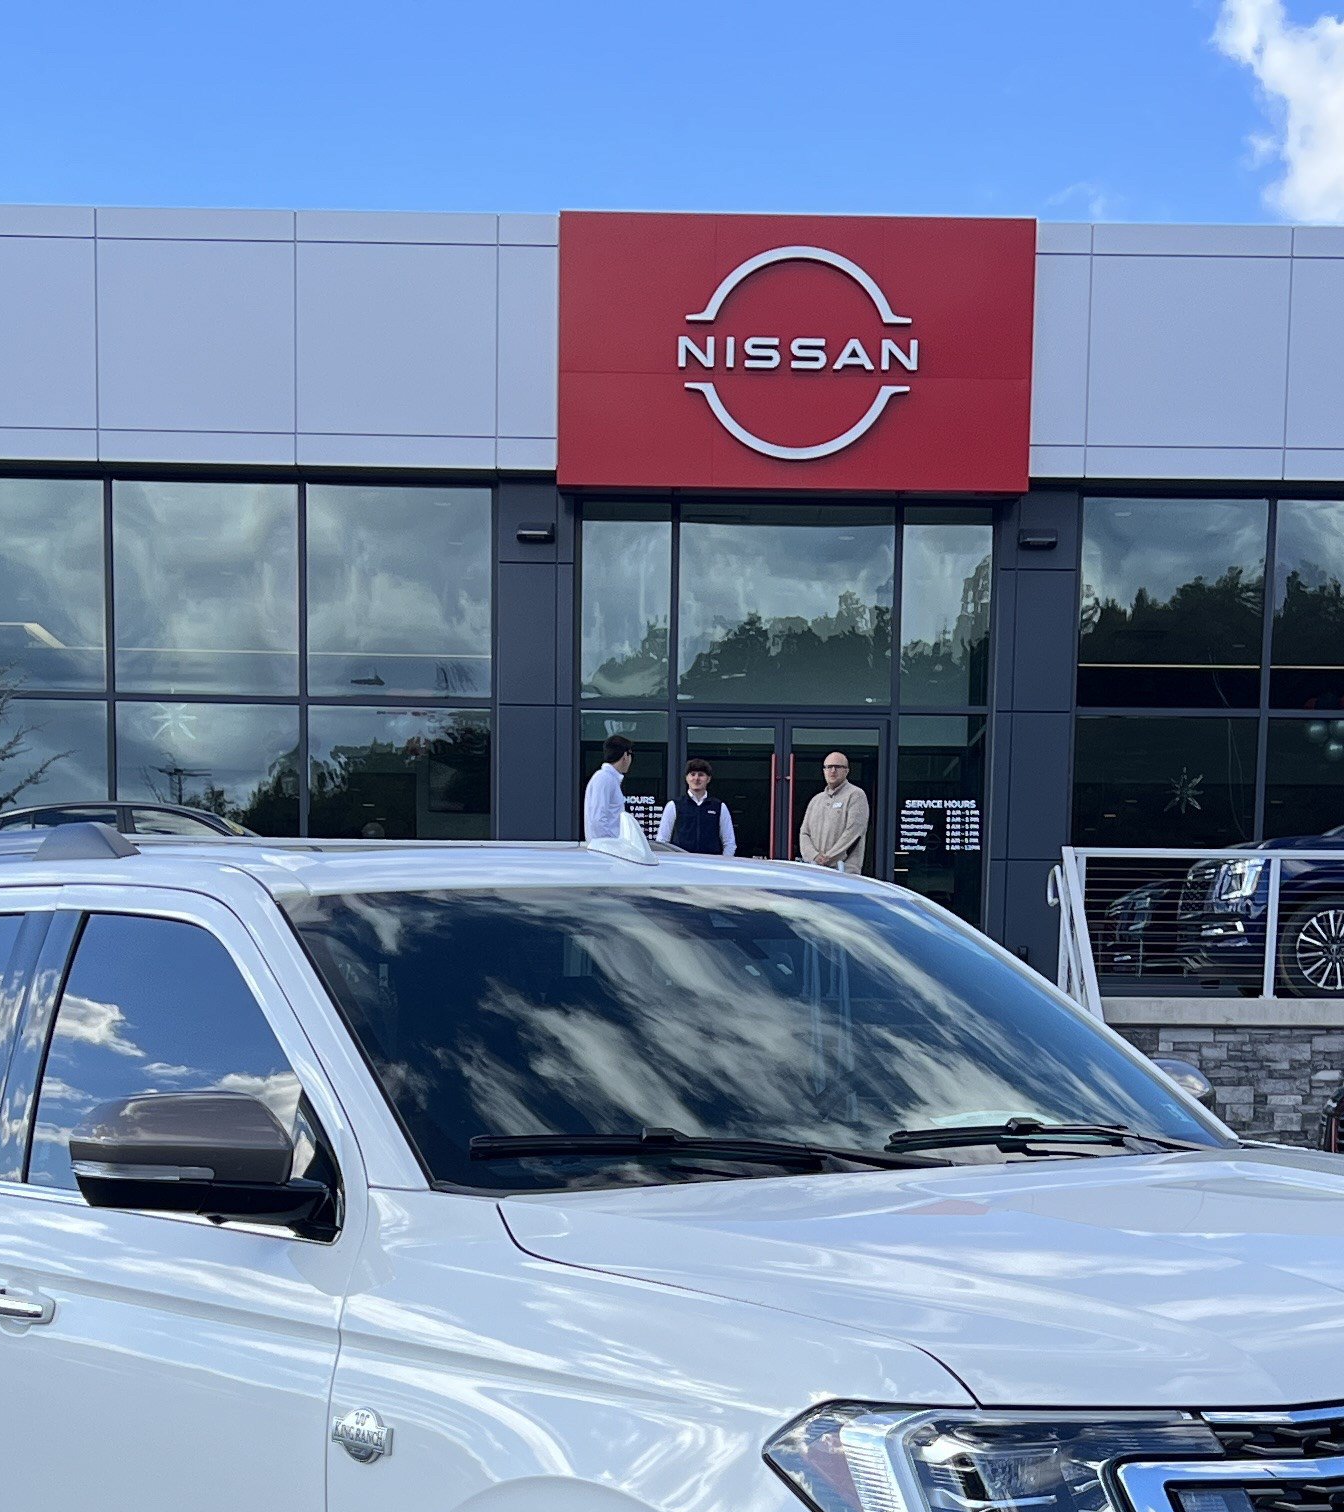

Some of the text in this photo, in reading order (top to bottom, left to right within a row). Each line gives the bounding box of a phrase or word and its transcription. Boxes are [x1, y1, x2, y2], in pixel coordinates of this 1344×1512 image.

[677, 335, 919, 372] NISSAN
[905, 800, 977, 809] SERVICE HOURS
[334, 1420, 384, 1448] KING RANCH
